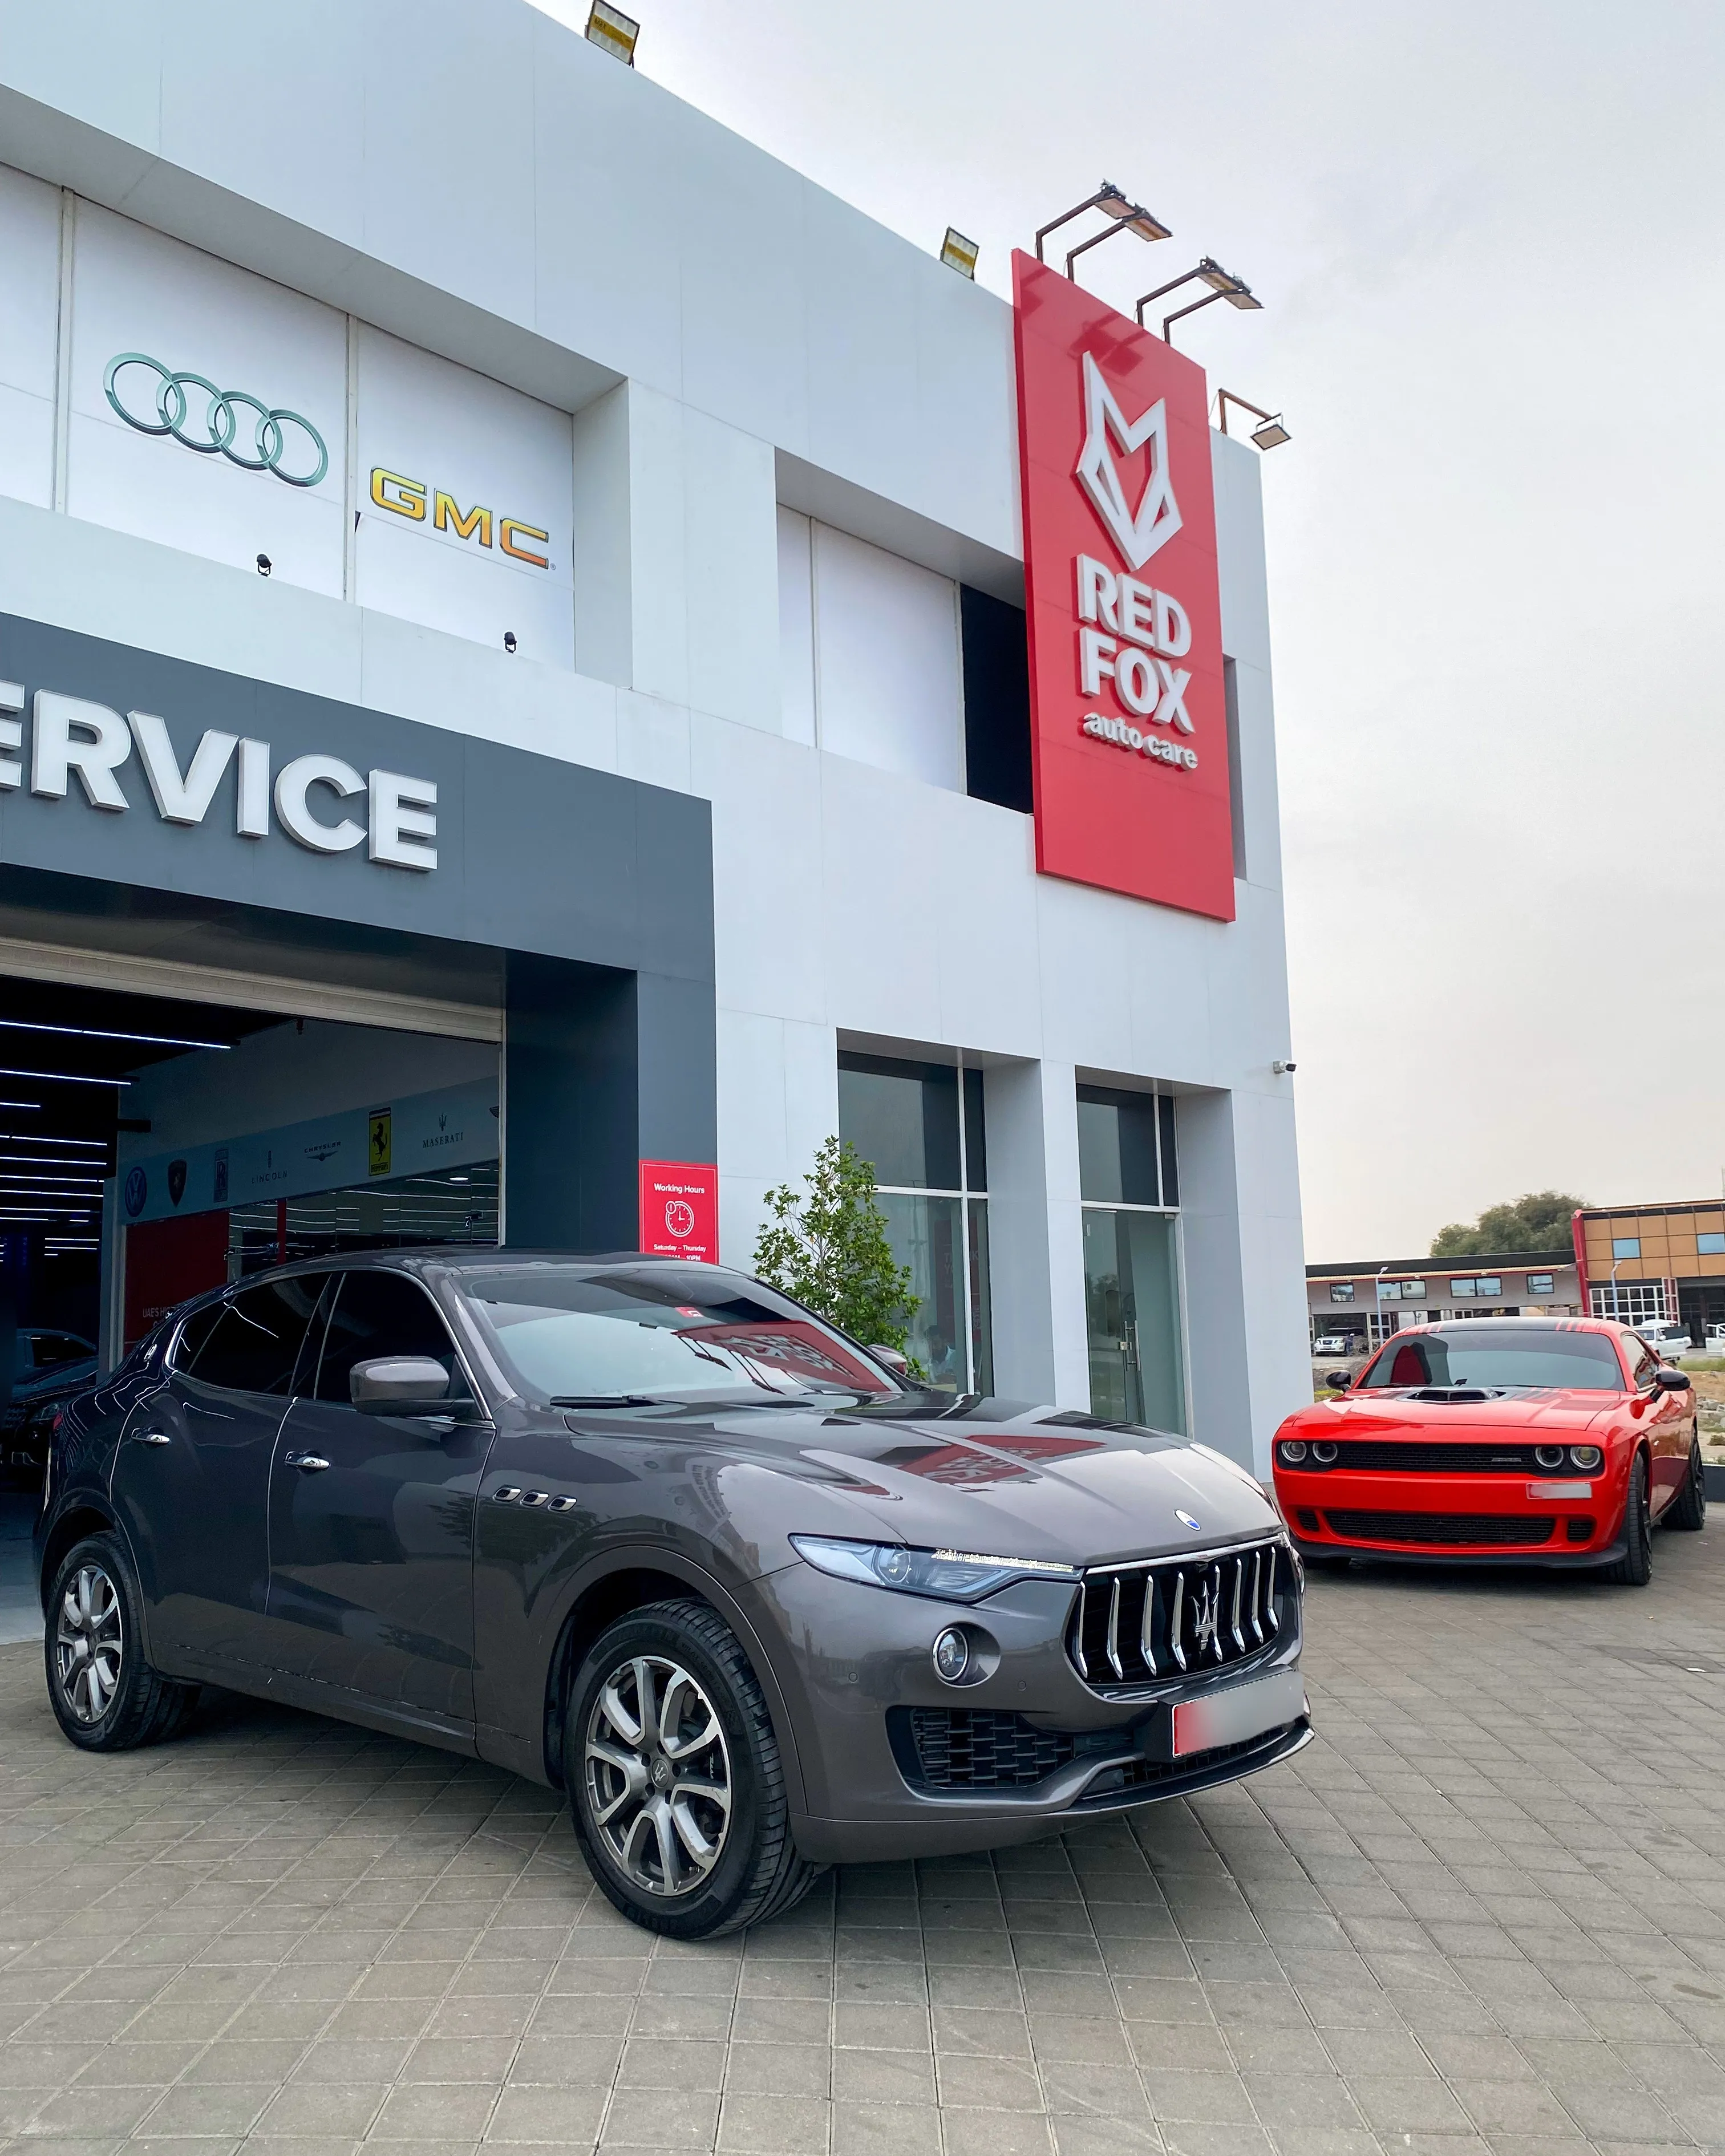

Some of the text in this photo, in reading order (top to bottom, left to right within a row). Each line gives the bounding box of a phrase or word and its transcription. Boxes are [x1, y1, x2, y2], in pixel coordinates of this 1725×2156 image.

[370, 465, 549, 570] GMC
[1076, 553, 1192, 658] RED
[1079, 626, 1196, 733] FOX
[1083, 712, 1198, 769] auto care
[304, 1141, 341, 1153] CHRYSLER
[423, 1132, 464, 1148] MASERATI
[251, 1170, 288, 1184] LINCOLN
[654, 1182, 705, 1194] Working Hours
